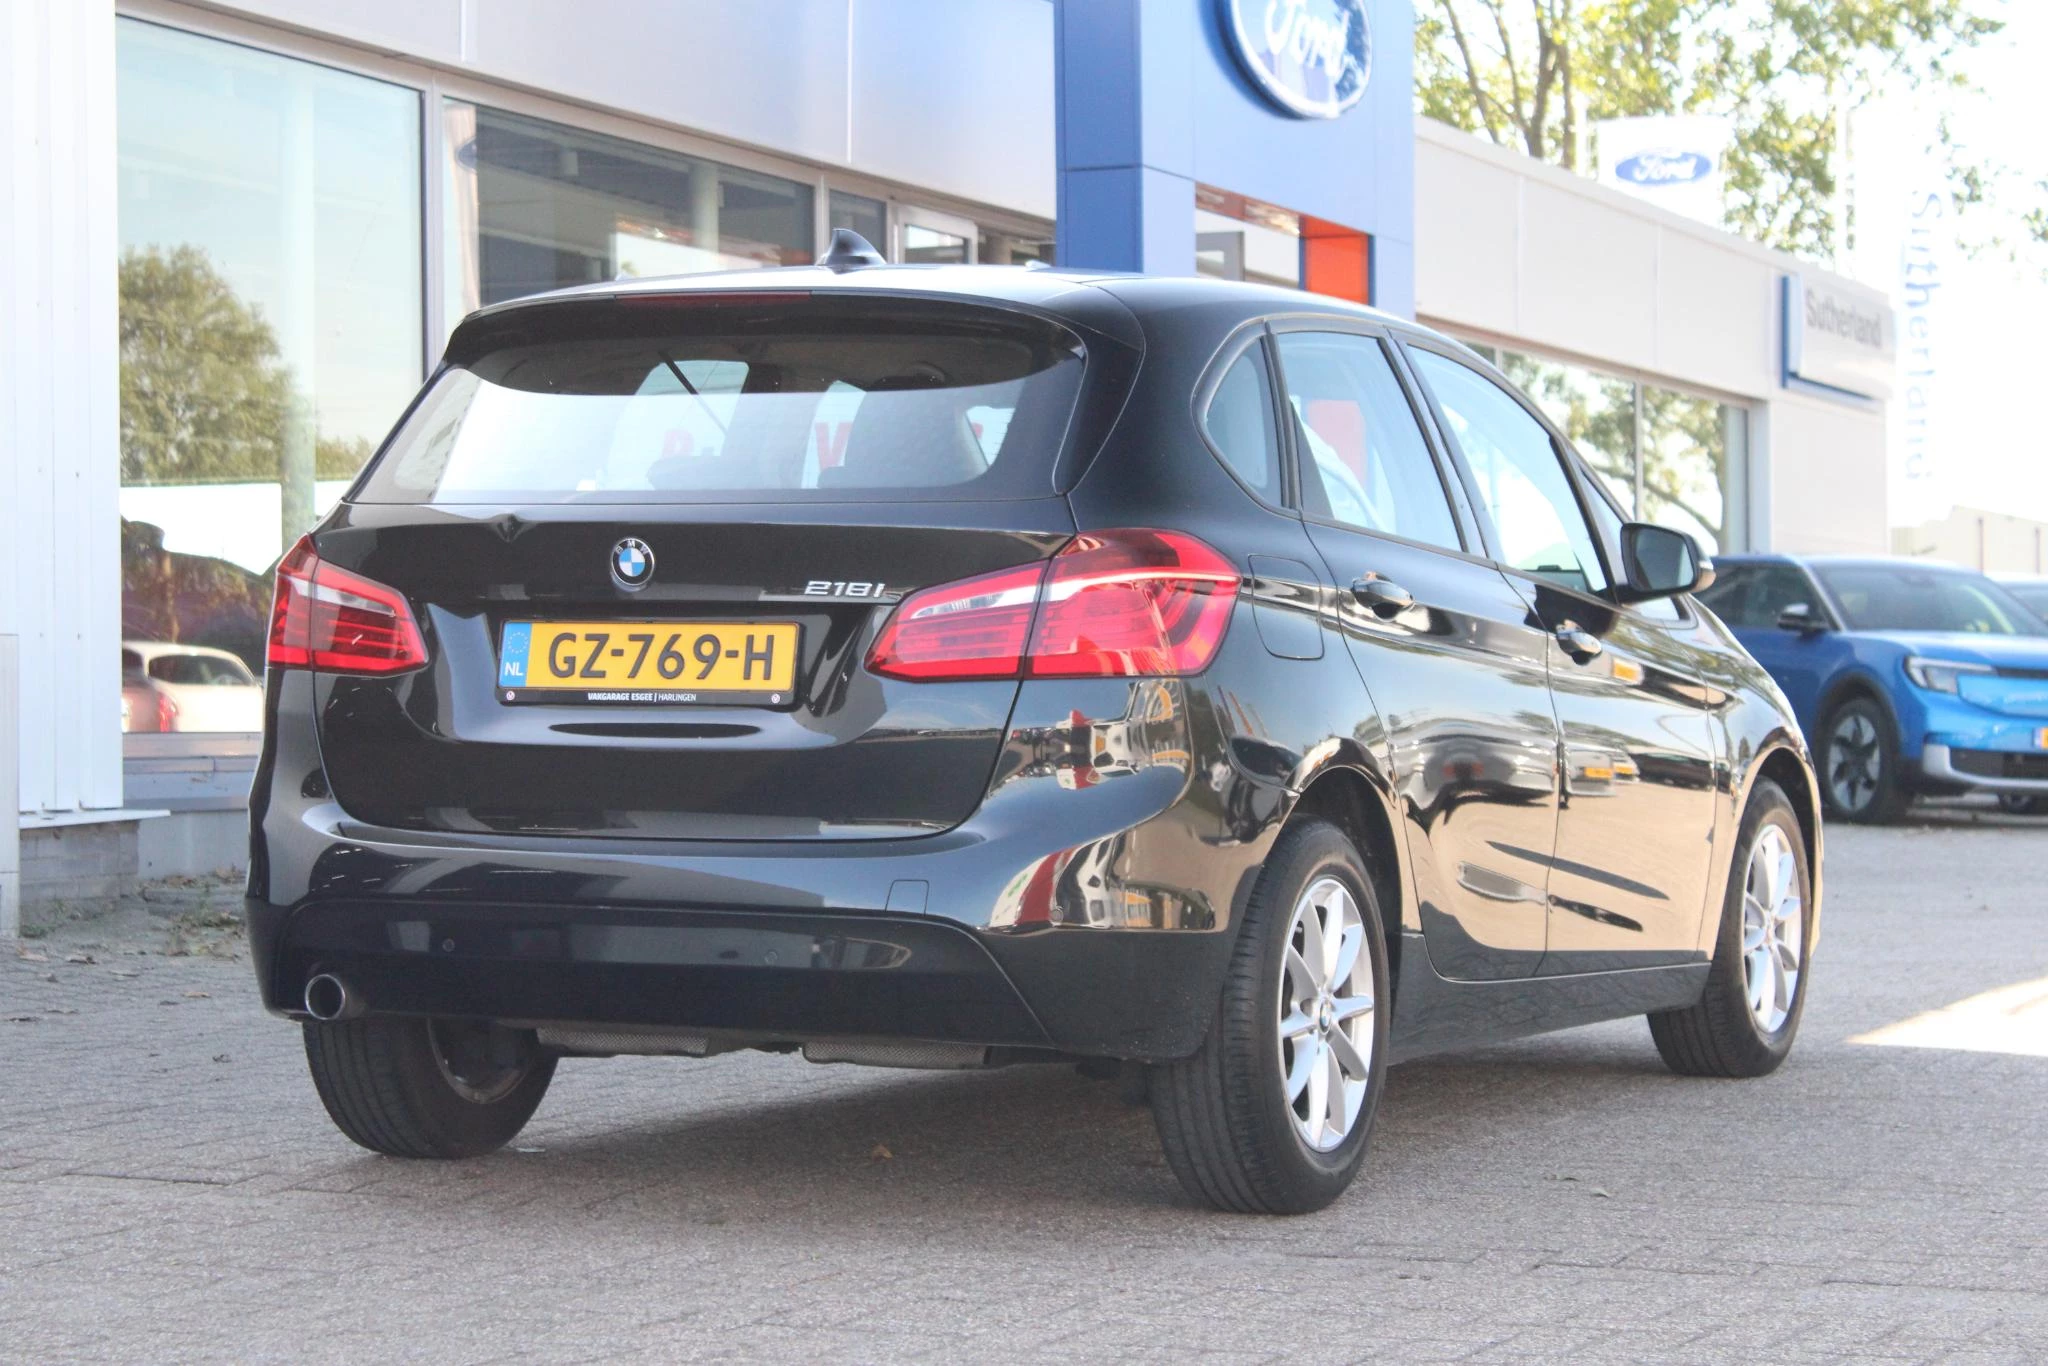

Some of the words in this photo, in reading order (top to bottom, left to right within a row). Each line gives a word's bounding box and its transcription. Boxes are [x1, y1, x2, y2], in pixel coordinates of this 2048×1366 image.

[1631, 153, 1698, 181] Ford
[1805, 287, 1883, 350] Sutherland
[615, 540, 650, 554] BMW
[548, 632, 775, 681] GZ-769-H
[504, 662, 523, 676] NL
[587, 692, 630, 701] VAKGARAGE
[631, 692, 653, 701] ESGEE
[658, 693, 697, 702] HARLINGEN
